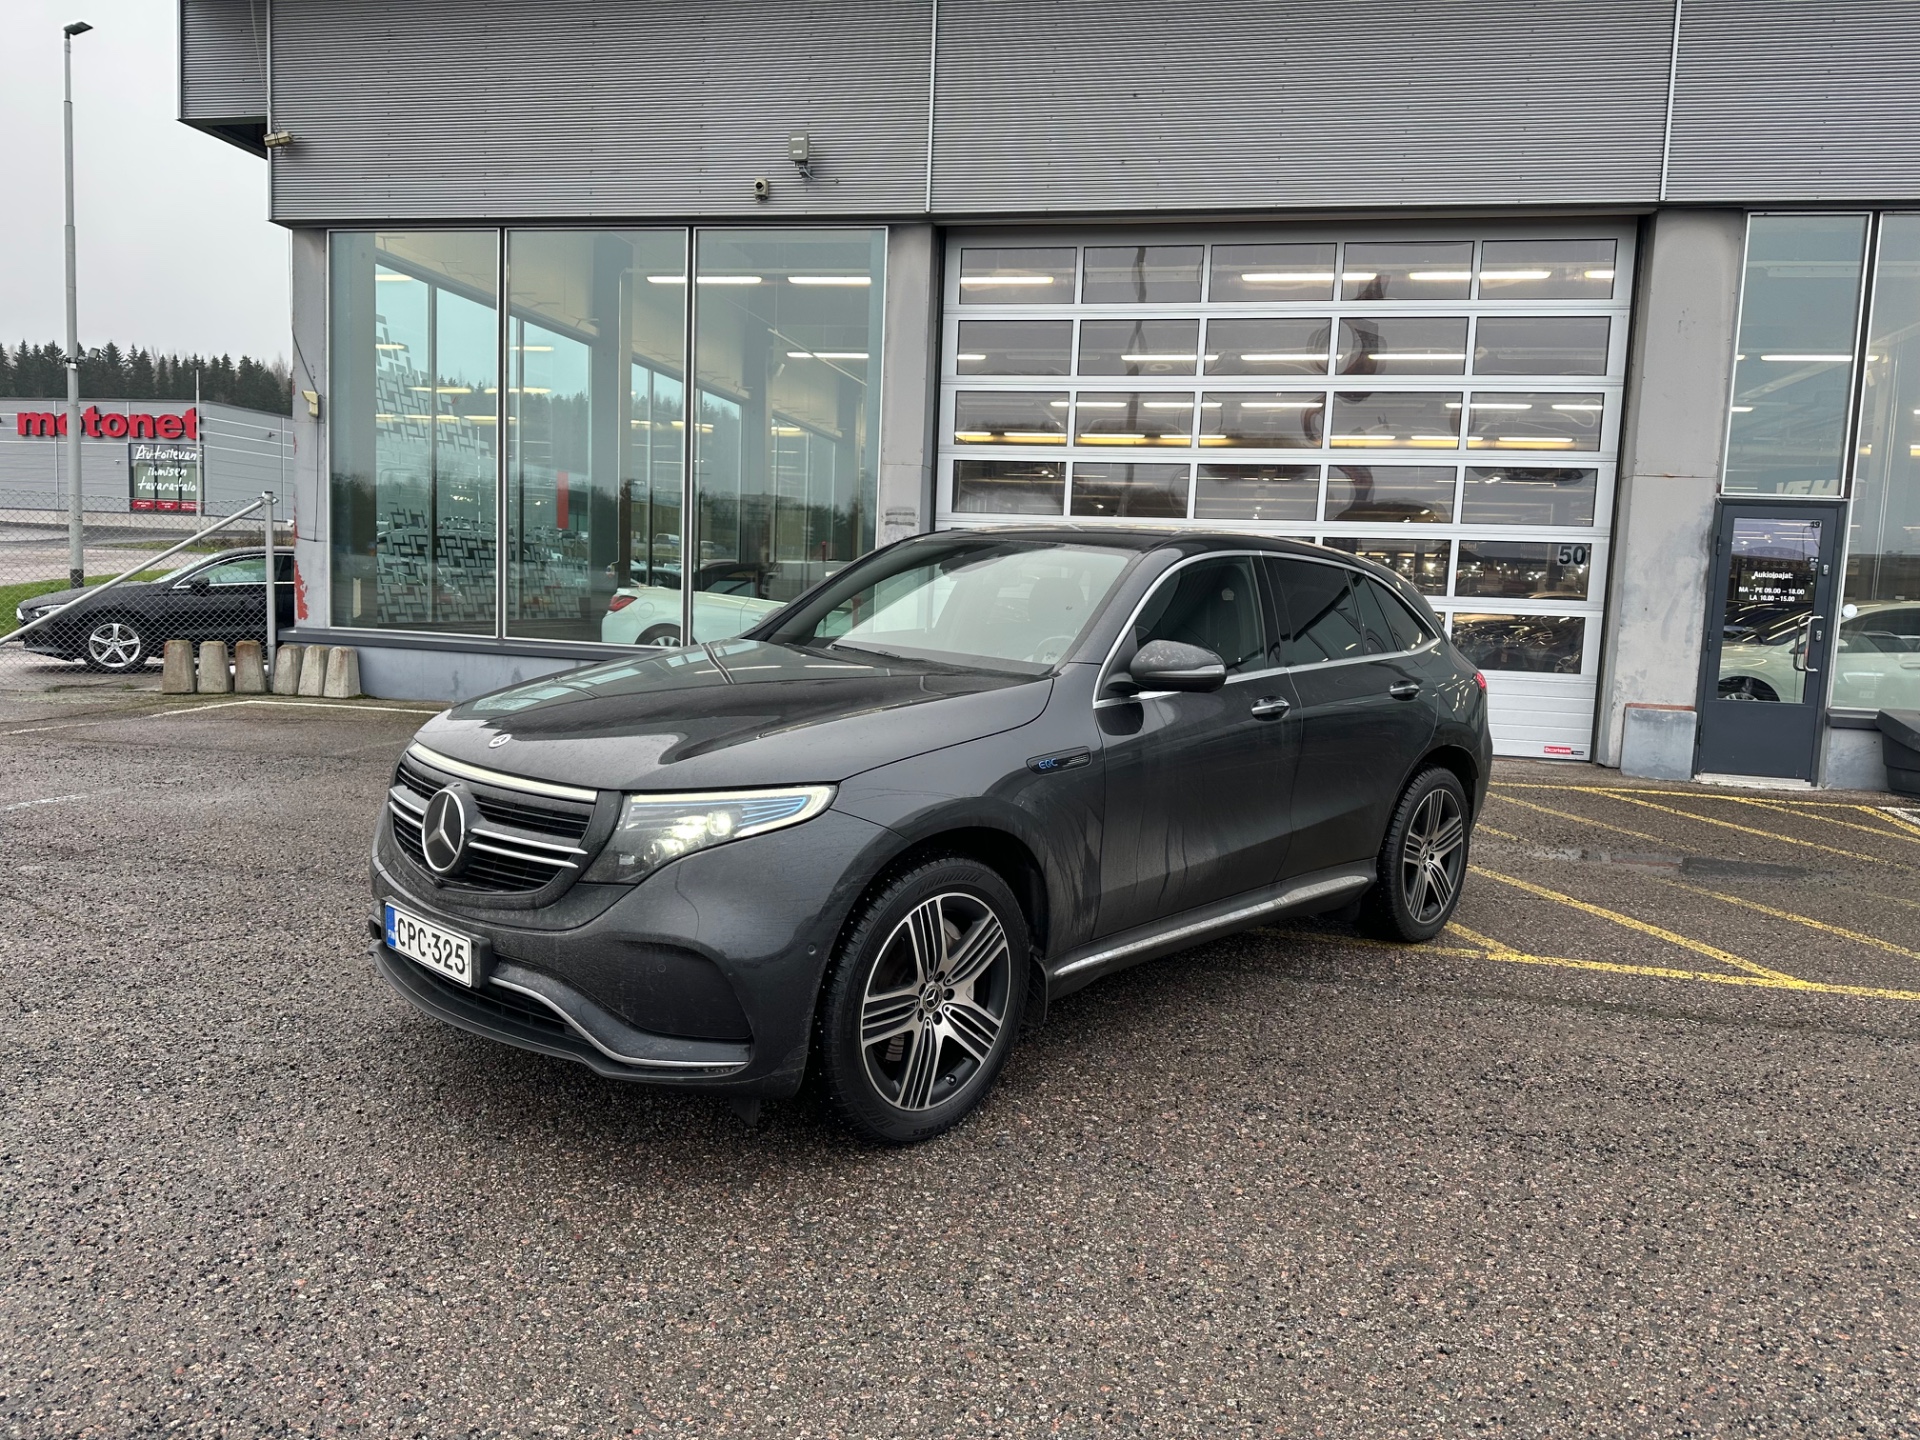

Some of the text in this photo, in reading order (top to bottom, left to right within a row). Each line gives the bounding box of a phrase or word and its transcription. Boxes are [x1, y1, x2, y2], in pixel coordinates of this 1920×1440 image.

[17, 405, 202, 440] motonet
[1558, 545, 1586, 565] 50
[1039, 758, 1058, 769] EQC
[397, 917, 466, 974] CPC-325
